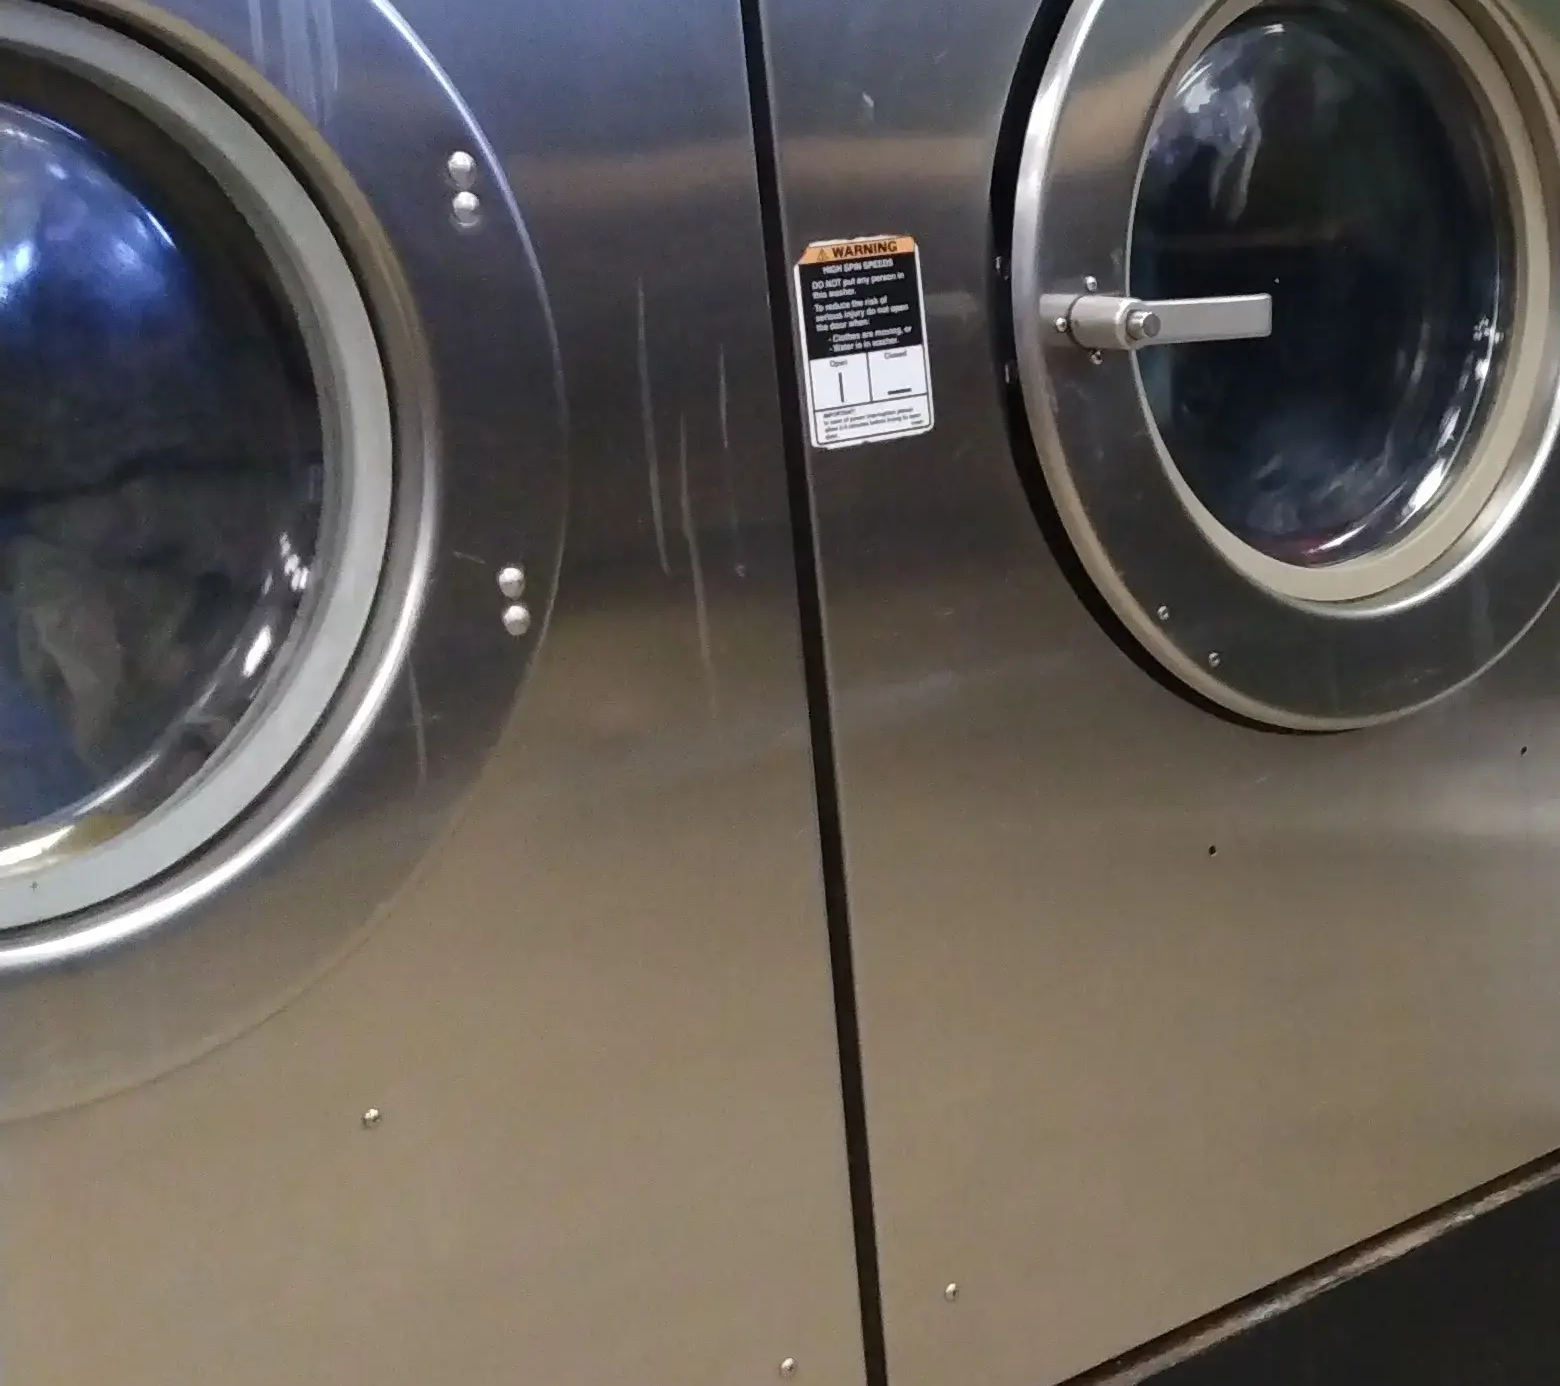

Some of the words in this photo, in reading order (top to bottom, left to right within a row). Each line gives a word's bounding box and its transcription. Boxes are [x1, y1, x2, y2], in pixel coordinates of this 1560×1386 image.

[832, 241, 898, 258] WARNING
[812, 280, 824, 290] DO
[825, 278, 841, 288] NOT
[829, 359, 848, 368] Open
